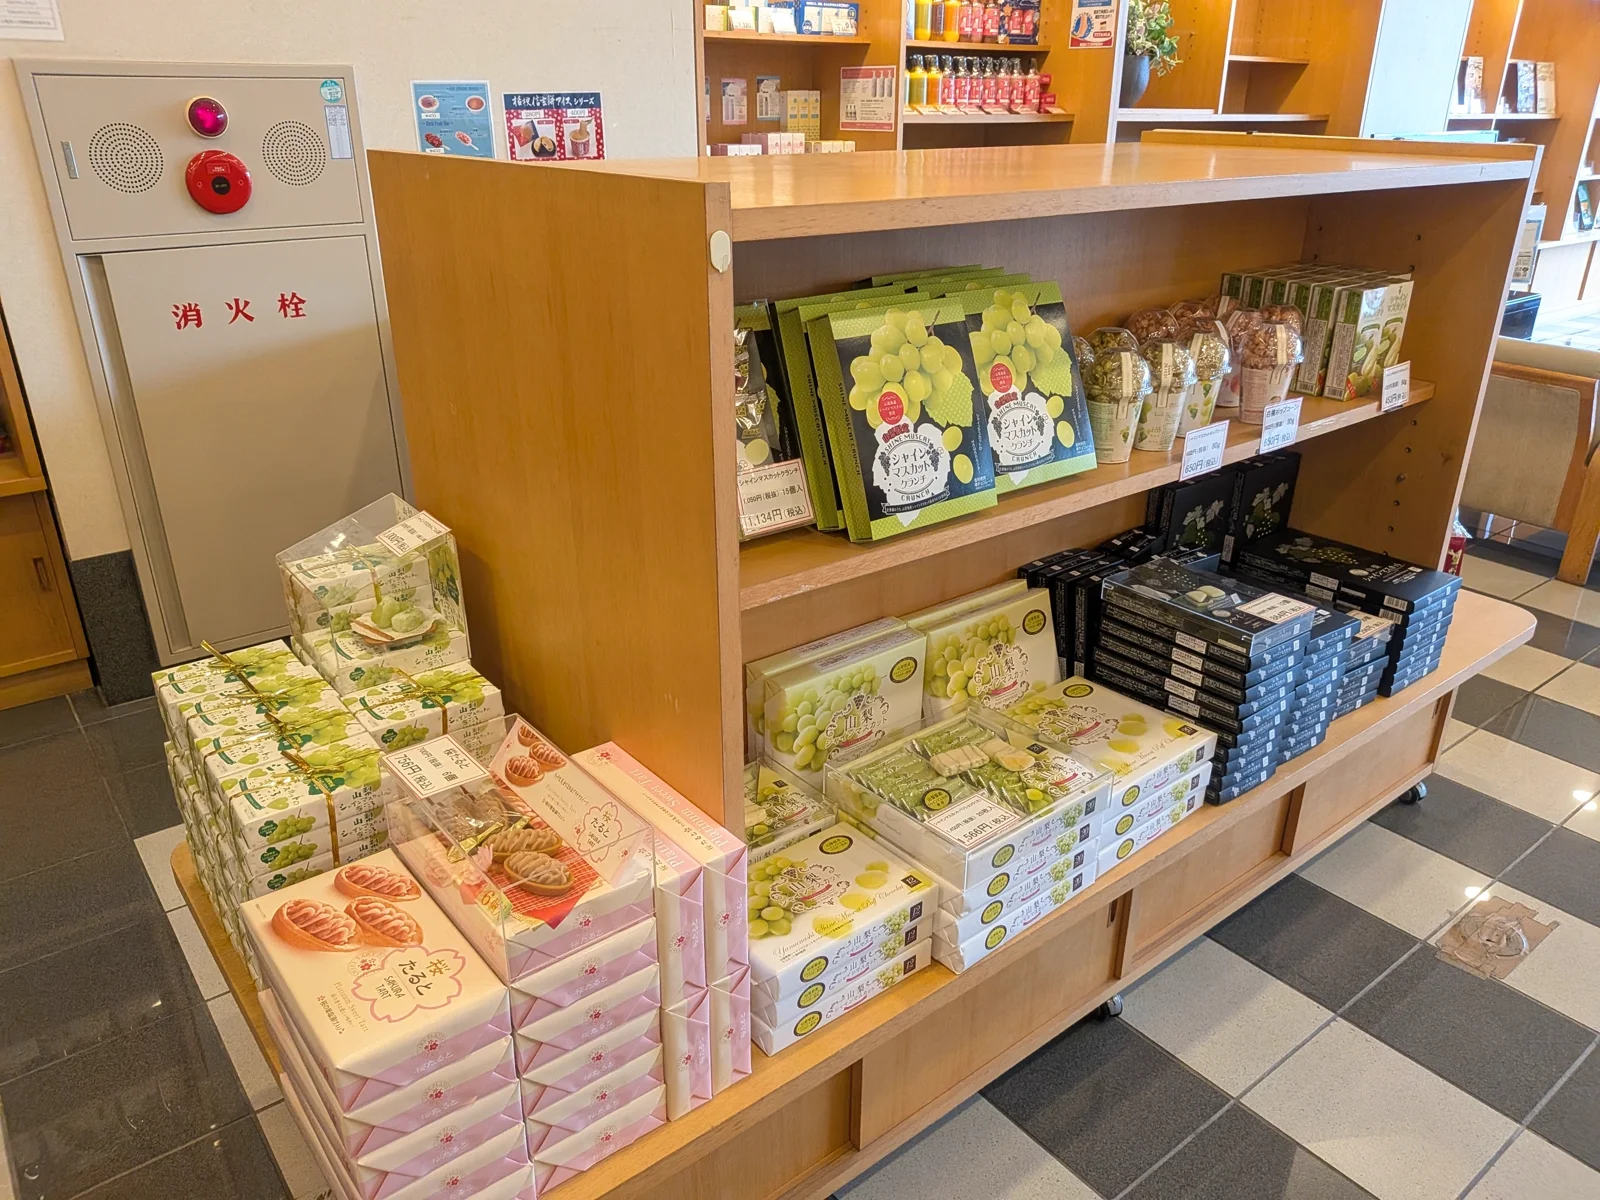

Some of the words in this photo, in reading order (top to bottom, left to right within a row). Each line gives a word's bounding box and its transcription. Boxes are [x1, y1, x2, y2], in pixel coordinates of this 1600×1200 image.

[171, 291, 307, 330] 消火栓
[997, 402, 1013, 418] SHINE
[1013, 400, 1037, 412] MUSCAT
[1003, 413, 1034, 430] シャイン
[1003, 425, 1038, 441] マスカット
[884, 436, 903, 453] SHINE
[903, 434, 931, 444] MUSCAT
[1010, 438, 1034, 451] クランチ
[891, 447, 927, 466] シャイン
[1011, 451, 1038, 463] CRUNCH
[1184, 456, 1219, 474] 650円(税込)
[891, 461, 931, 478] マスカット
[782, 484, 803, 496] 15個入
[900, 475, 927, 489] クランチ
[900, 489, 930, 502] CRUNCH
[990, 657, 1015, 680] 山梨
[844, 708, 874, 732] 山梨
[443, 748, 471, 770] 桜たると
[395, 753, 436, 790] 756円(税込)
[441, 771, 459, 782] 6個
[590, 817, 610, 839] たると
[682, 808, 729, 847] Platinum
[788, 870, 820, 894] 山梨
[426, 958, 451, 977] 桜
[384, 975, 406, 999] SAKURA
[398, 959, 433, 996] たると
[375, 983, 392, 1000] TART
